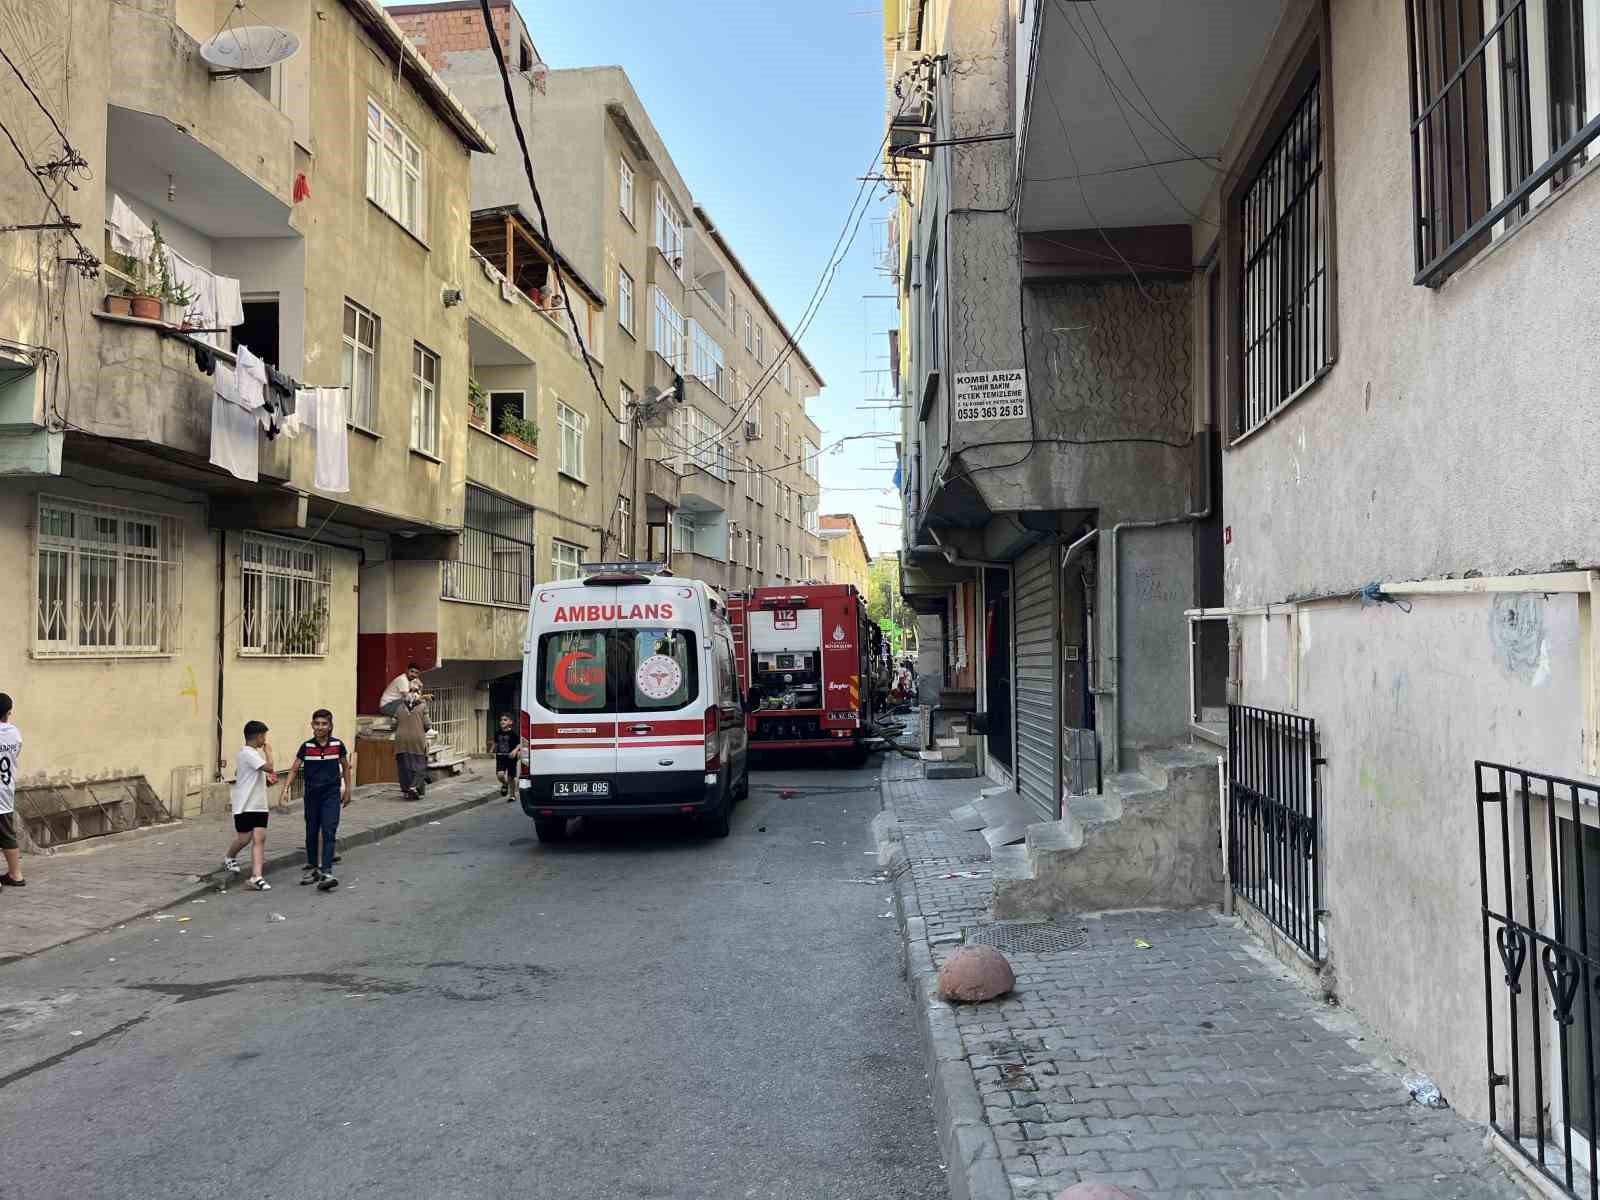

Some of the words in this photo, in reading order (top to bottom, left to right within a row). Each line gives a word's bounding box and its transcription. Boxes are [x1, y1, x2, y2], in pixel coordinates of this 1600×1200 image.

[992, 373, 1022, 382] ARIZA
[957, 408, 979, 419] 0535
[981, 407, 997, 418] 363
[999, 406, 1011, 417] 25
[1013, 405, 1024, 416] 83
[553, 604, 673, 622] AMBULANS
[777, 609, 795, 620] 112
[0, 756, 12, 786] 9
[559, 783, 569, 793] 34
[592, 782, 607, 792] 095
